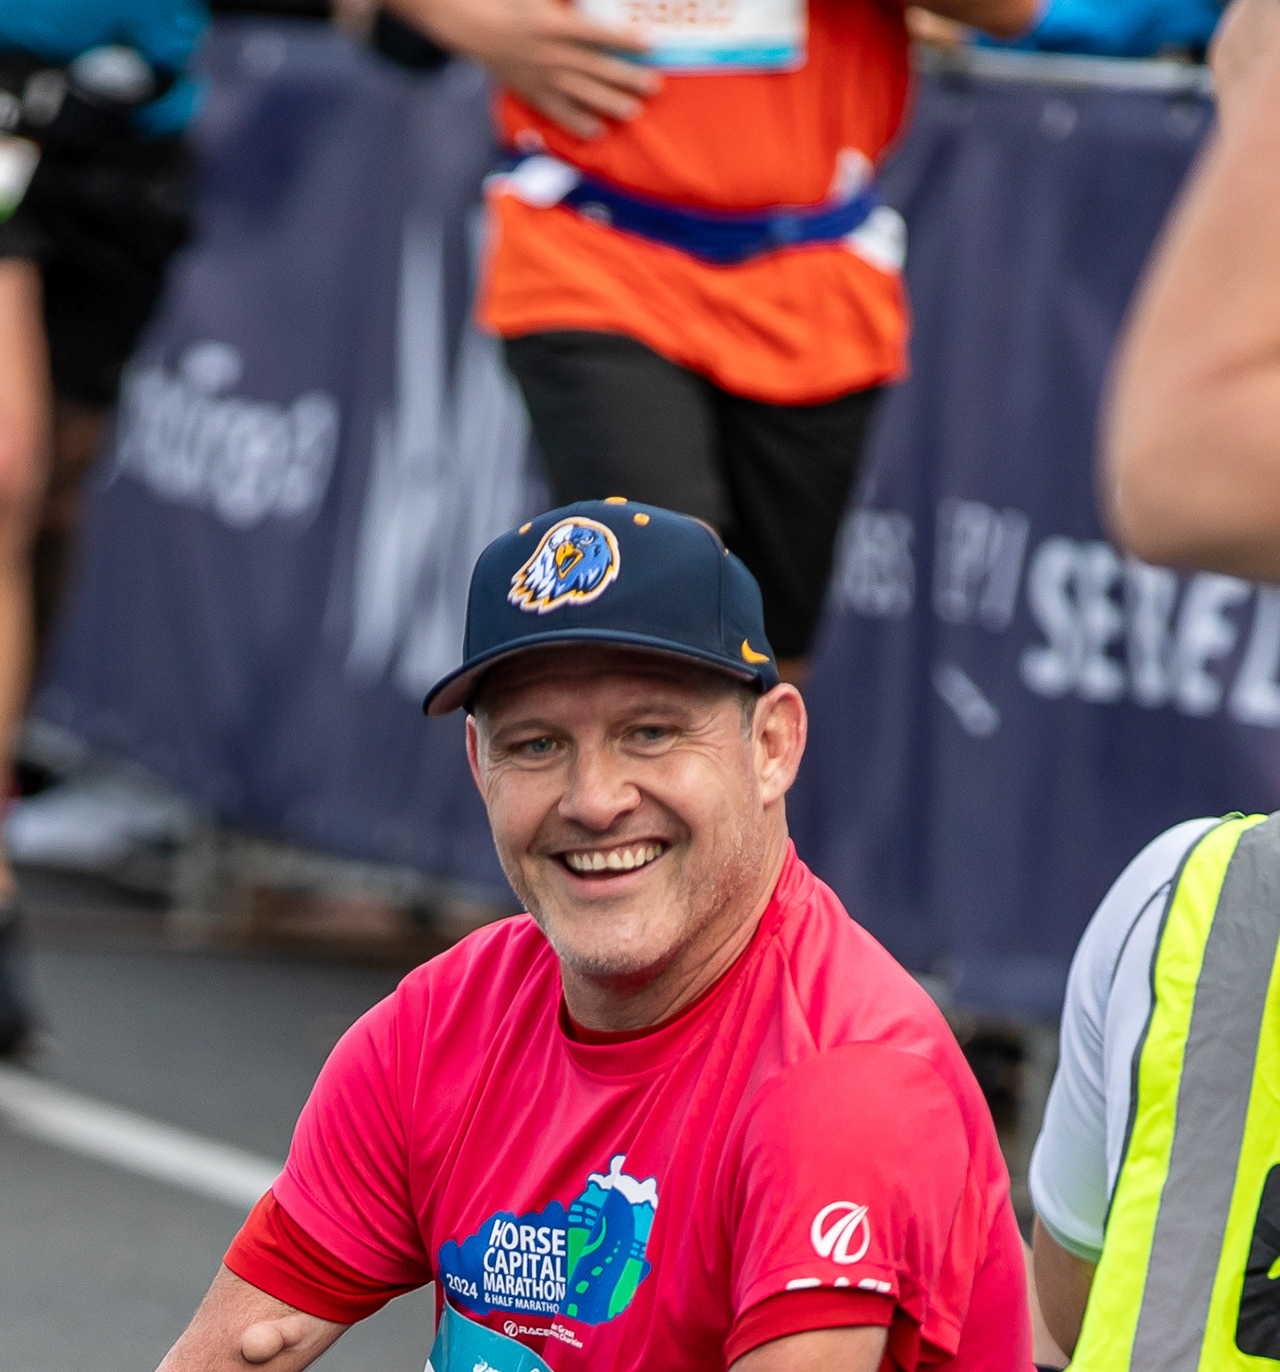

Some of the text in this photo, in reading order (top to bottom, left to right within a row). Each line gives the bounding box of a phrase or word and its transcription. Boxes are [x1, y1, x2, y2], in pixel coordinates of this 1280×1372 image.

[489, 1219, 566, 1257] HORSE
[483, 1247, 566, 1282] CAPITAL
[446, 1273, 479, 1299] 2024
[483, 1271, 566, 1302] MARATHON
[484, 1292, 559, 1313] & HALF MARATHO
